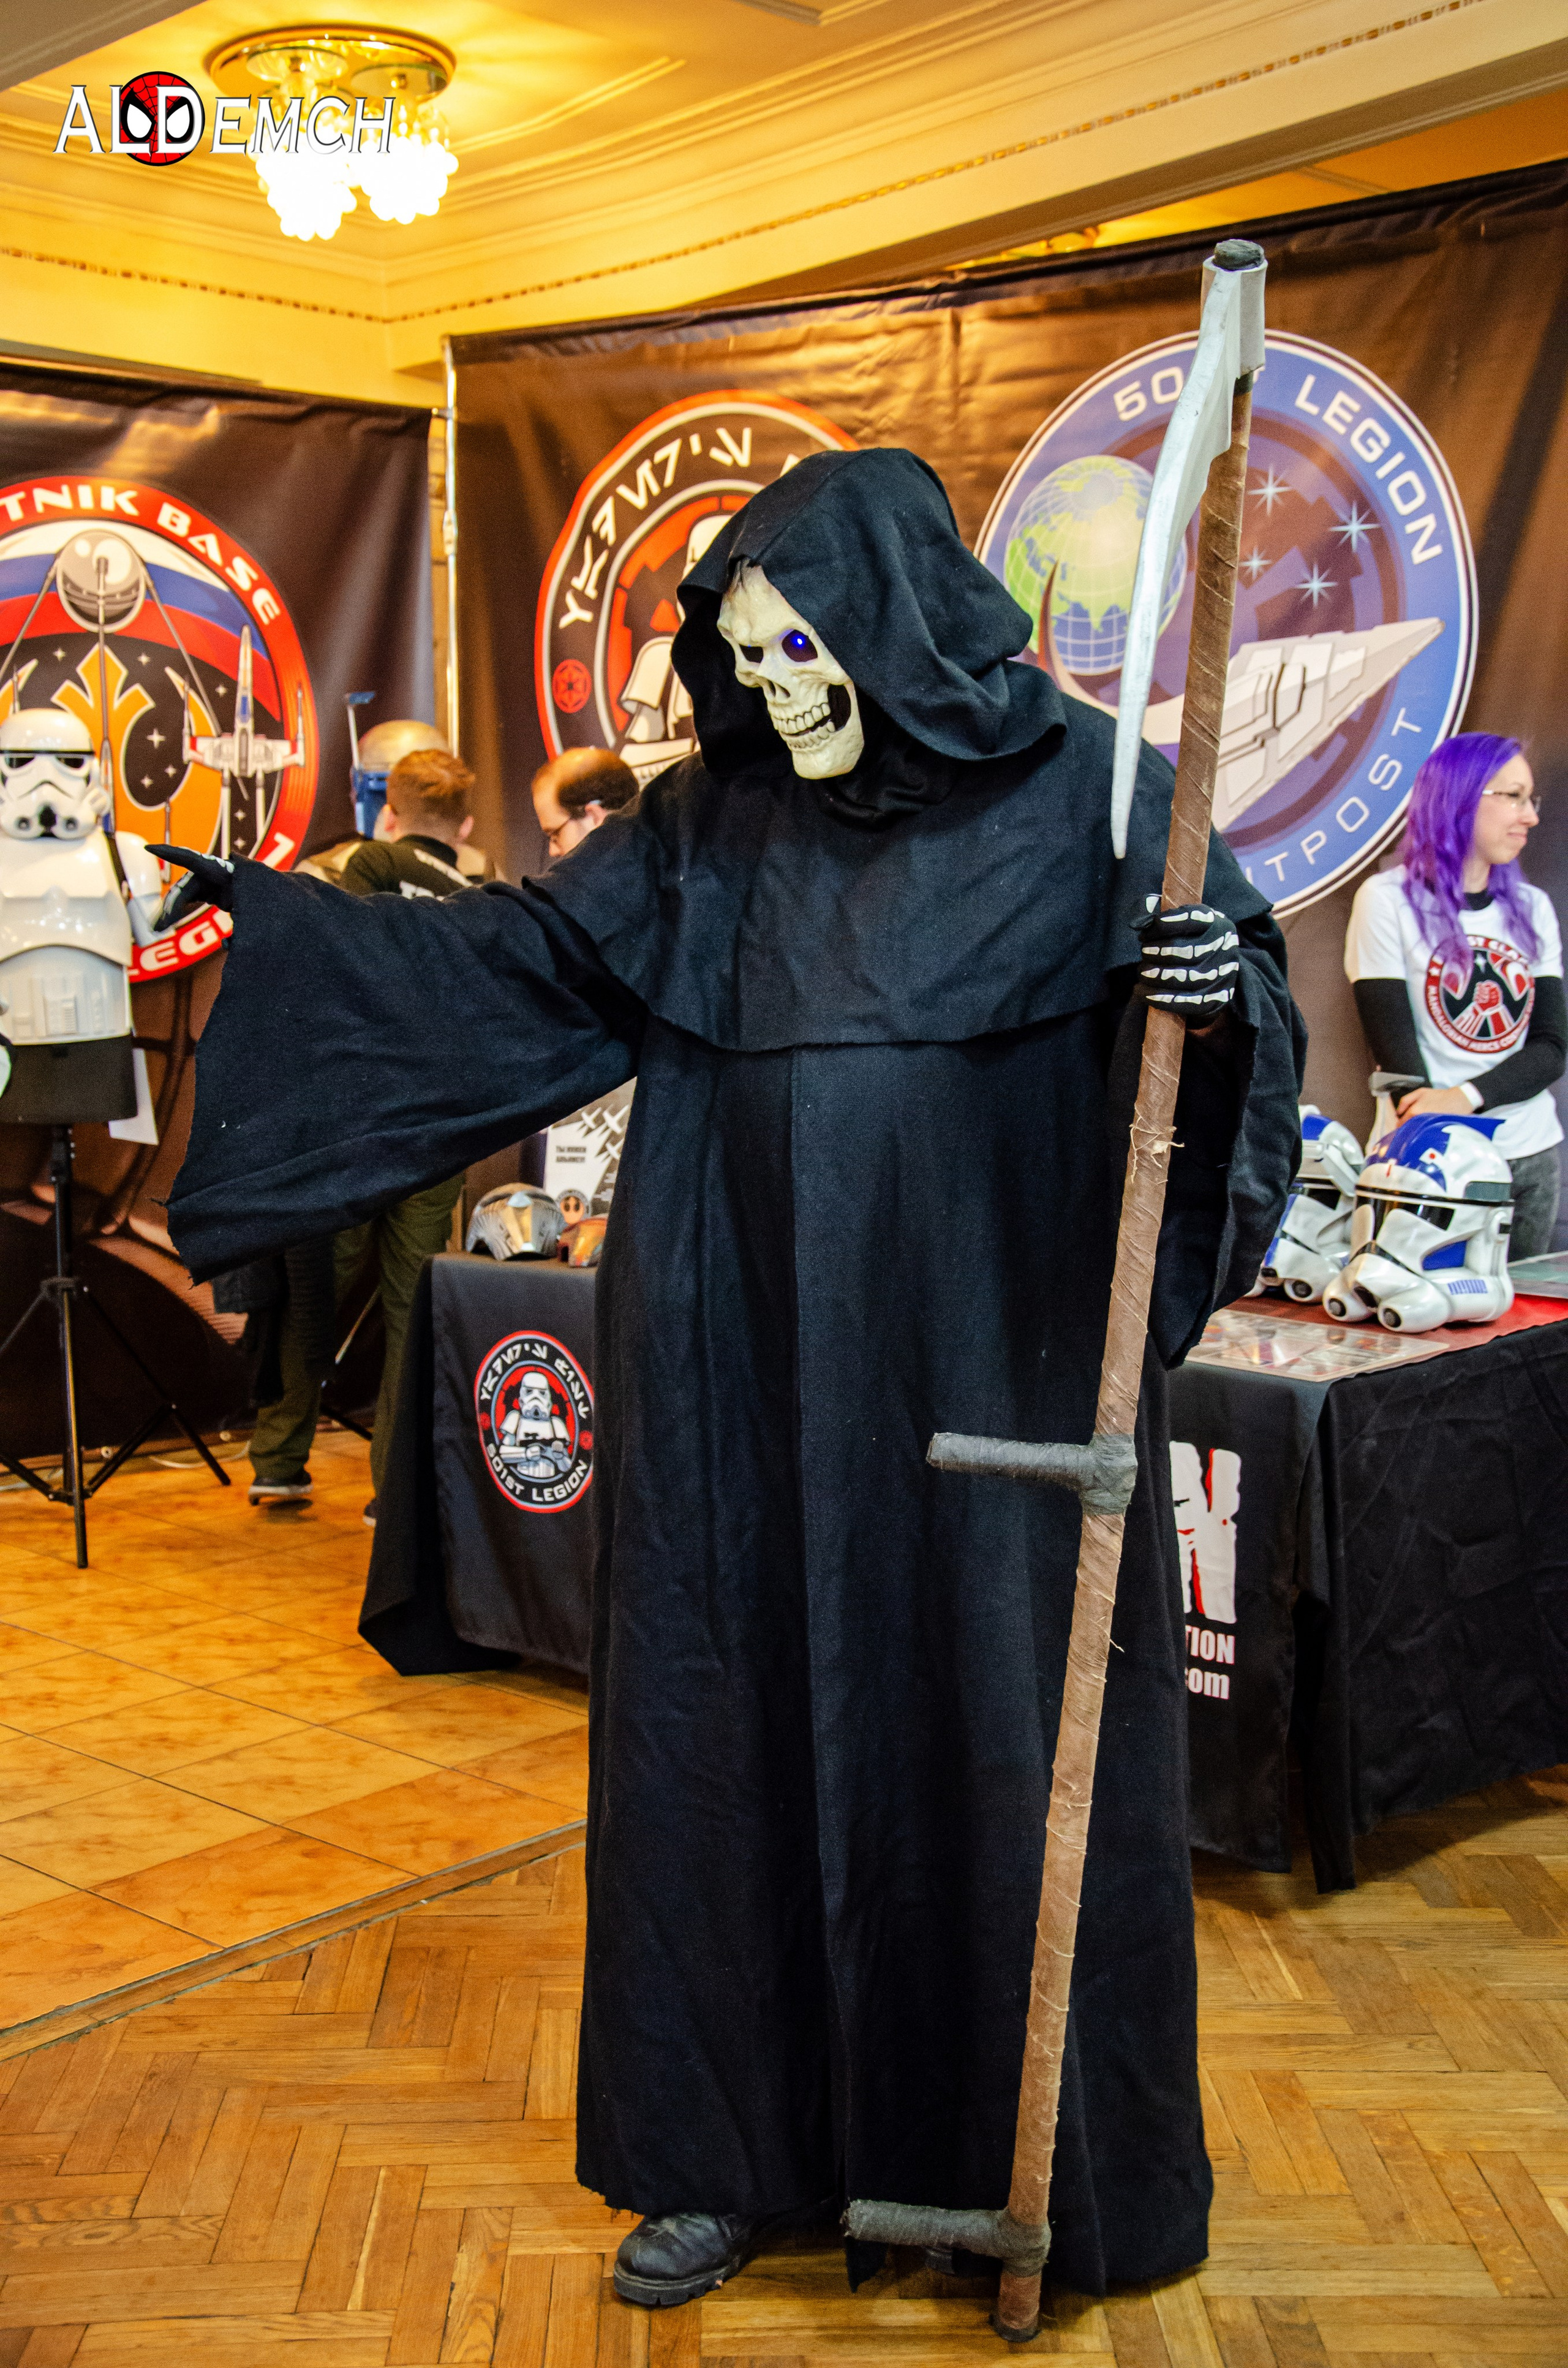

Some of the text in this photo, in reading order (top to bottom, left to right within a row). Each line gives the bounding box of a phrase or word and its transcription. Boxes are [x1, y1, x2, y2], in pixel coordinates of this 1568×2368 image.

[1294, 373, 1443, 566] LEGION
[157, 502, 281, 626] BASE
[1245, 707, 1423, 884] TPOST
[532, 1459, 588, 1502] LEGION
